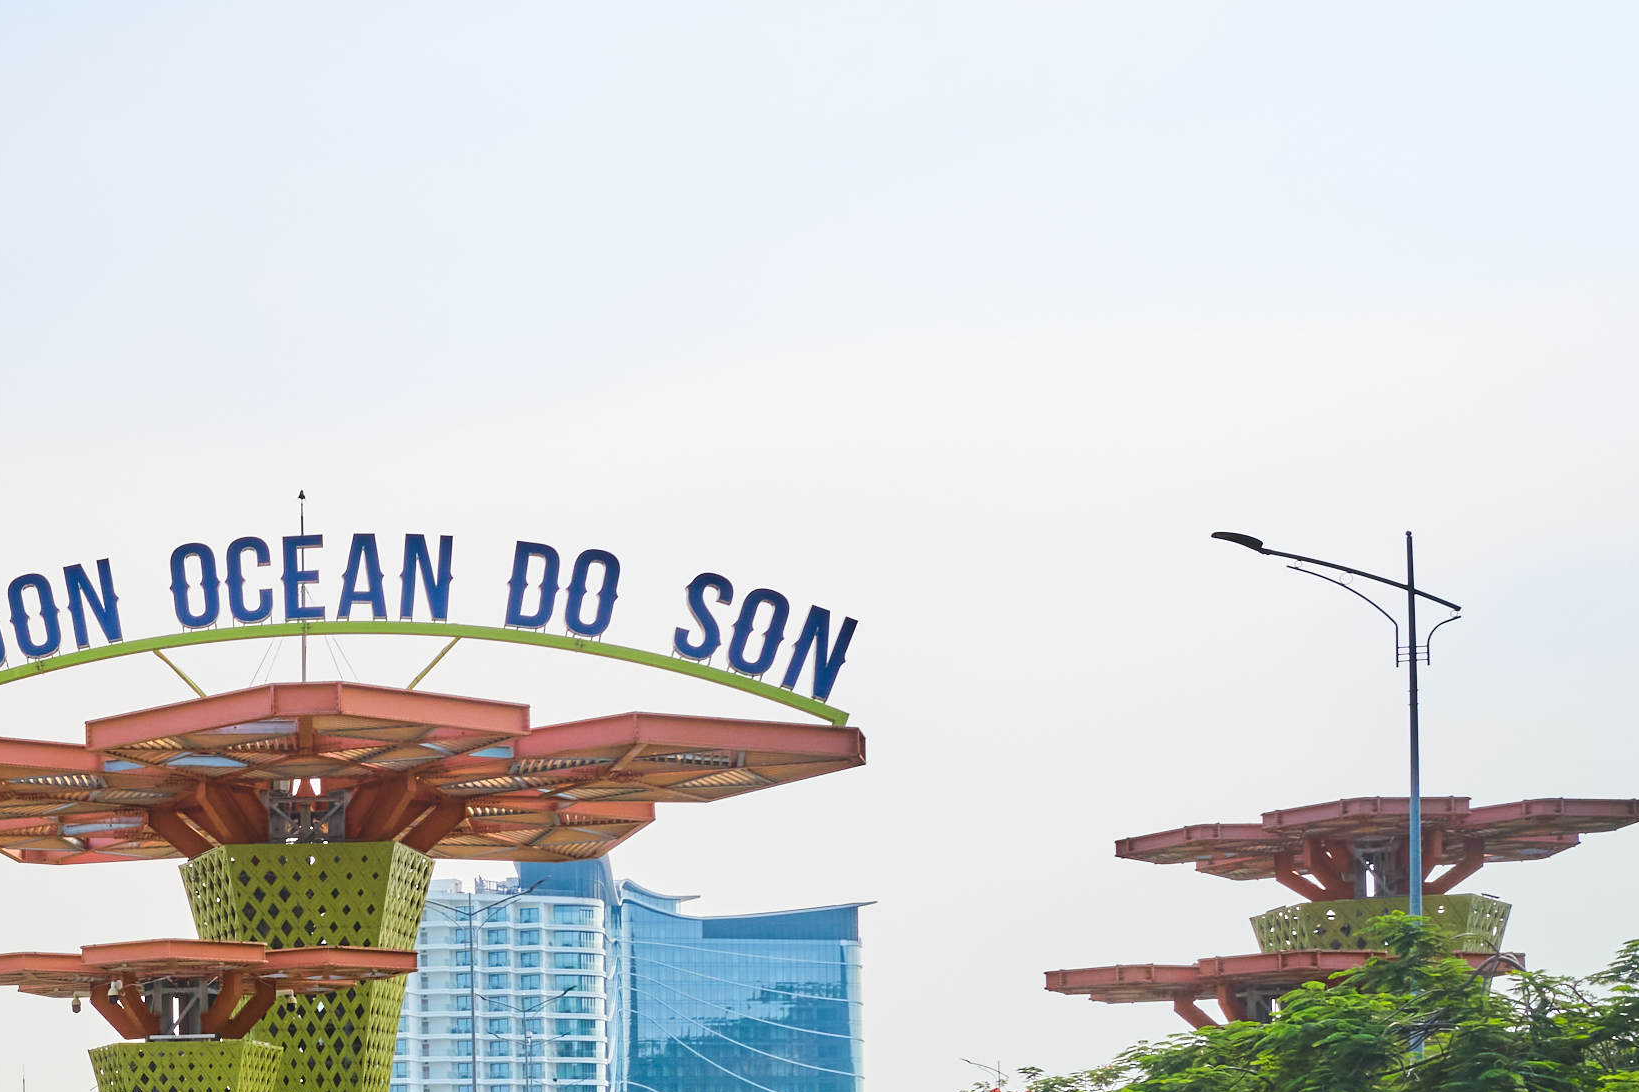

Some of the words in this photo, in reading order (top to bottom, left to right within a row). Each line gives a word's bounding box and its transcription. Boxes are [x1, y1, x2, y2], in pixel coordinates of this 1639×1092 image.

[169, 533, 454, 625] OCEAN
[505, 540, 623, 637] DO
[672, 573, 860, 702] SON
